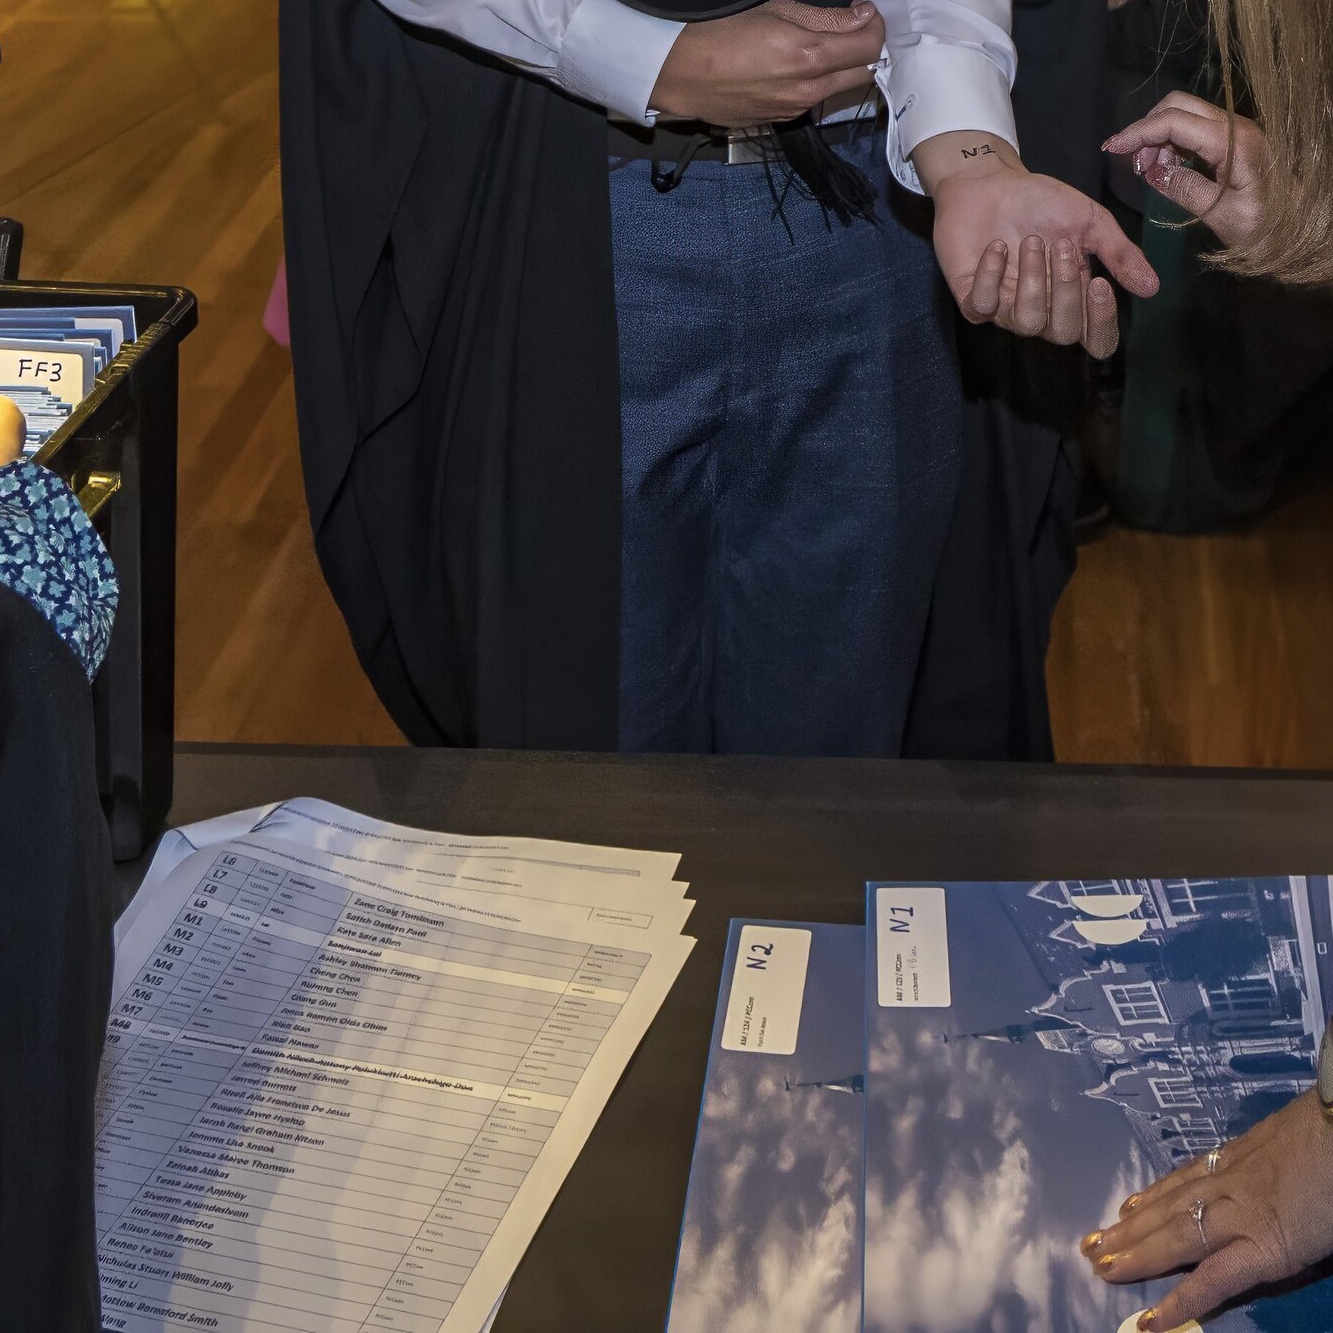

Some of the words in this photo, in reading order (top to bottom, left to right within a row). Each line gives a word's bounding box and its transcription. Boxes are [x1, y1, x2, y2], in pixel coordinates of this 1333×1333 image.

[18, 359, 62, 382] FF3
[184, 913, 202, 926] M1
[889, 907, 914, 933] N1
[174, 928, 194, 941] M2
[163, 942, 184, 957] M3
[746, 943, 774, 970] N2
[153, 958, 174, 971] M4
[142, 974, 162, 987] M5
[132, 988, 152, 1001] M6
[121, 1003, 142, 1017] M7
